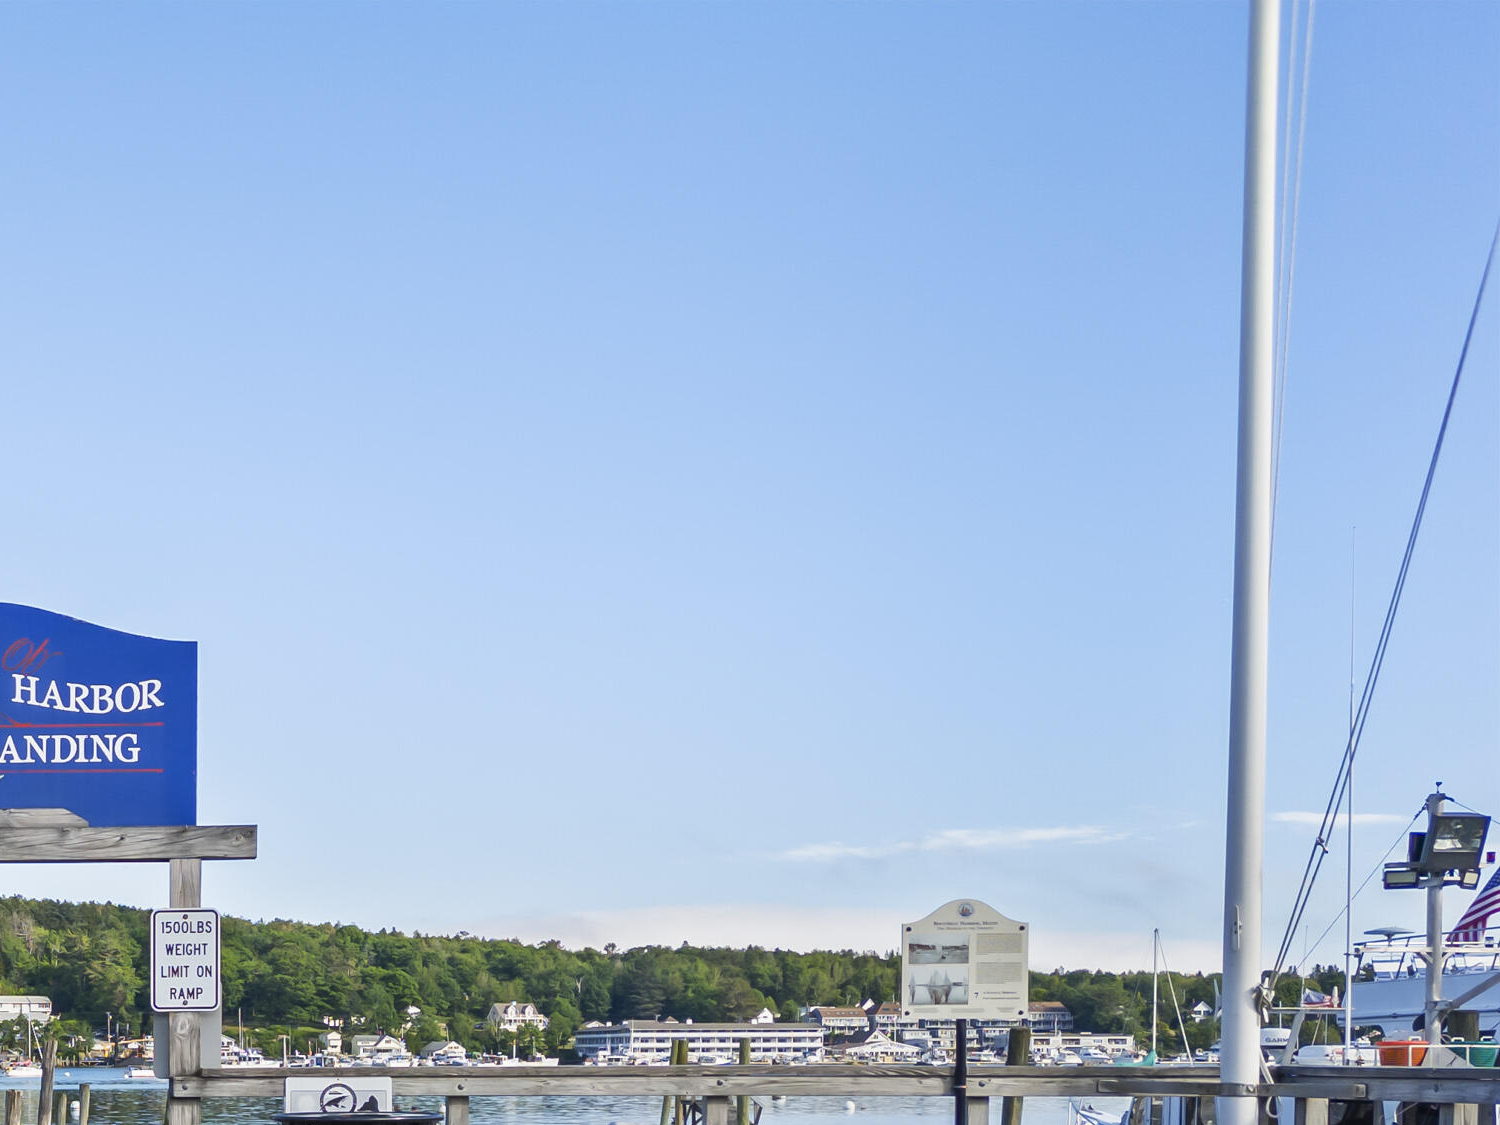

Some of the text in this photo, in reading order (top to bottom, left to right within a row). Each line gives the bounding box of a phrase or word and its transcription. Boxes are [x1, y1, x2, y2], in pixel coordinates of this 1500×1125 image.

[1, 637, 64, 675] Of
[11, 673, 165, 715] HARBOR
[161, 920, 213, 934] 1500LBS
[165, 943, 208, 956] WEIGHT
[160, 965, 213, 978] LIMIT ON
[169, 987, 203, 1000] RAMP
